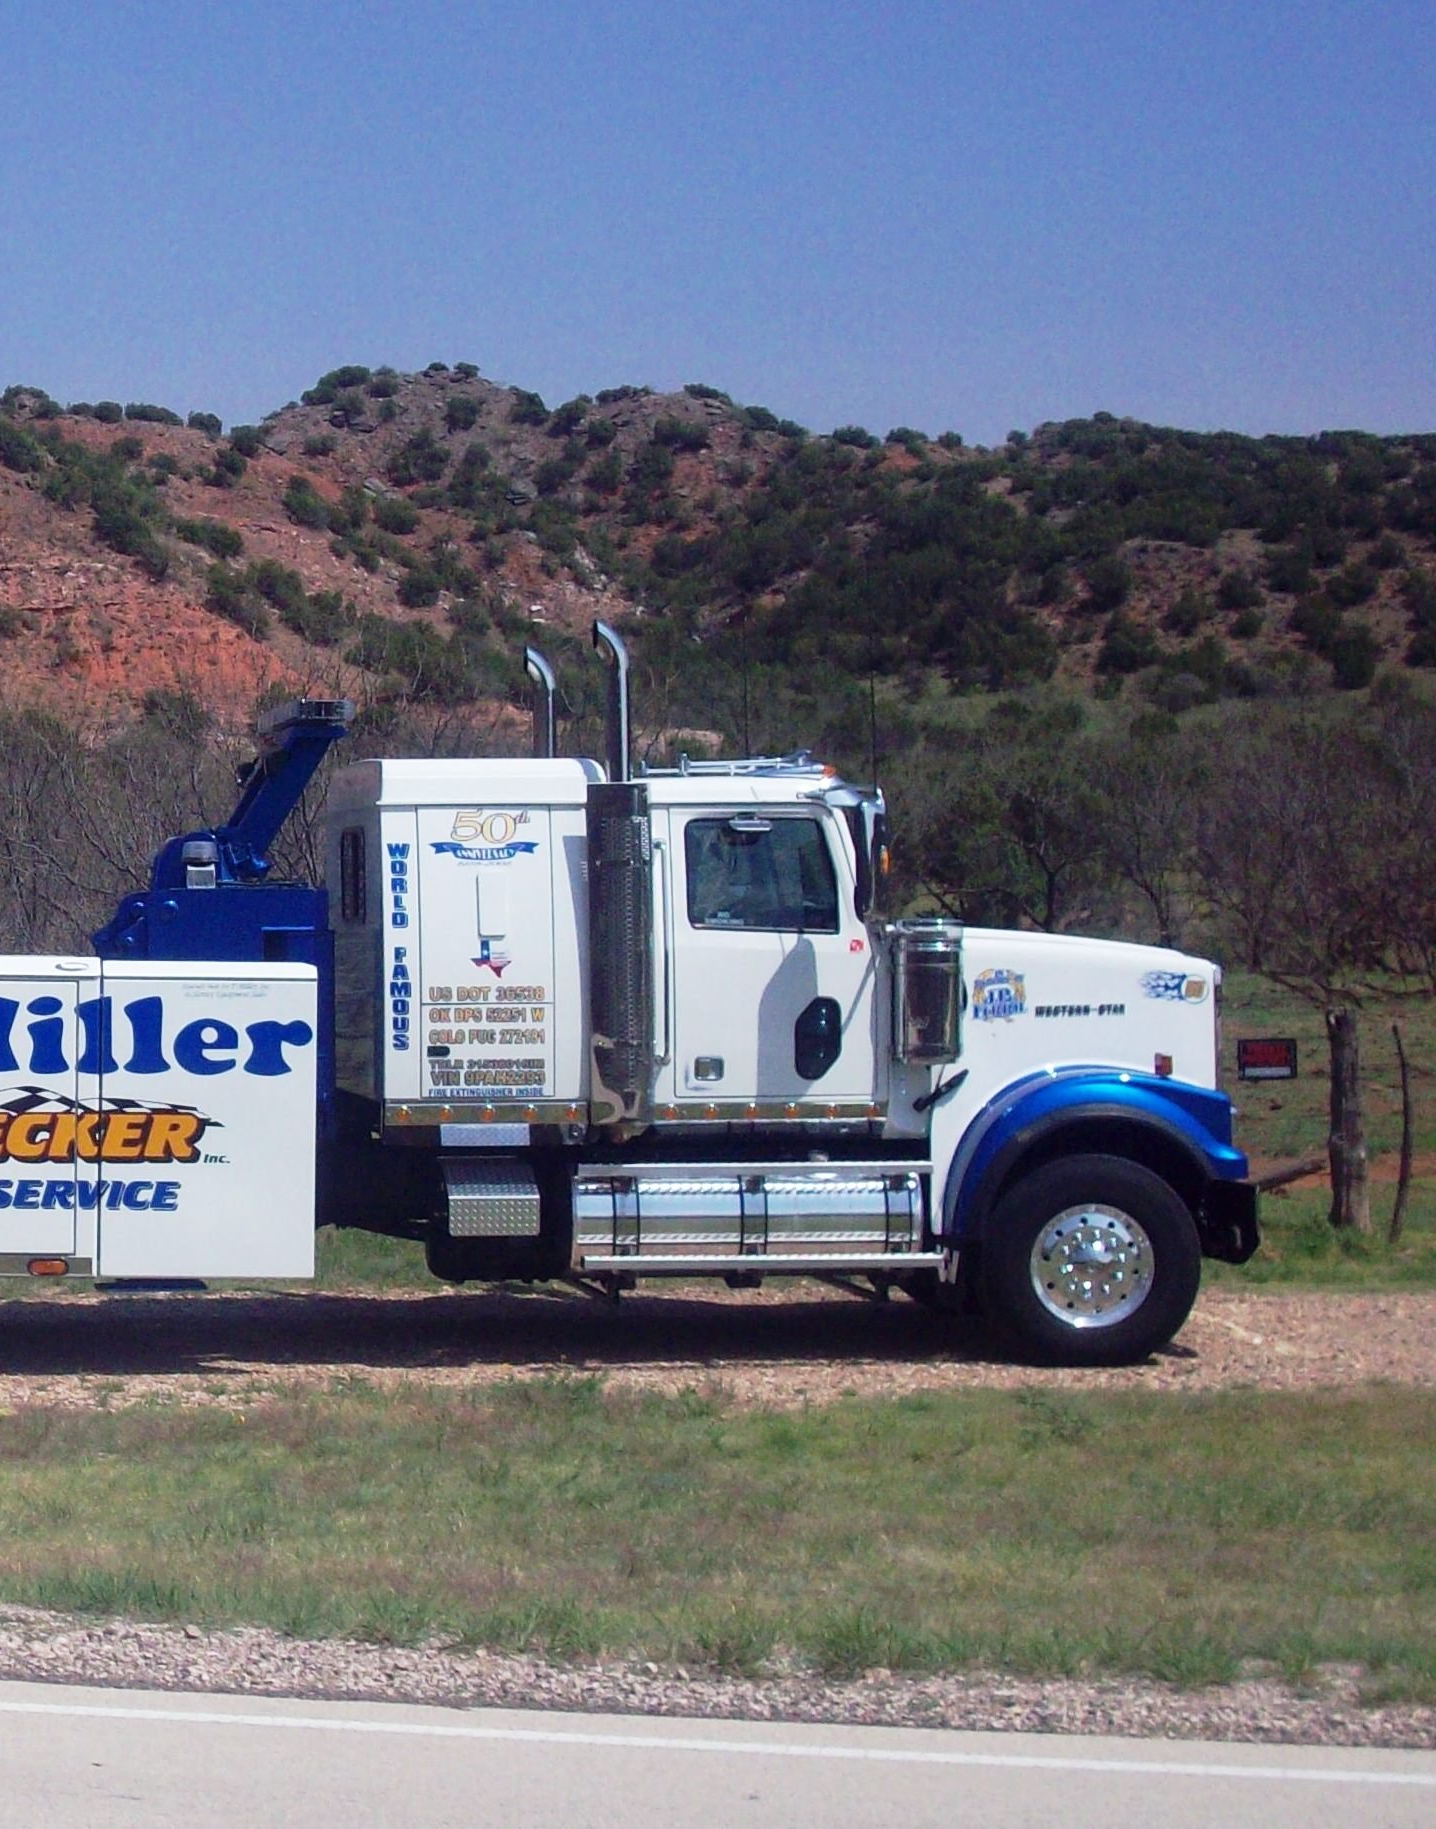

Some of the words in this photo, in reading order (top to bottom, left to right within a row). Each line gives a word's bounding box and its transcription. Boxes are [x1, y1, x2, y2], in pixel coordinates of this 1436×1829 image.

[386, 842, 411, 929] WORLD
[389, 946, 412, 1051] FAMOUS
[428, 986, 452, 1002] US
[456, 986, 491, 1002] DOT
[428, 1007, 451, 1023] OK
[530, 1007, 545, 1023] W
[429, 1087, 447, 1098] FIRE
[515, 1087, 544, 1097] INSIDE
[203, 1152, 231, 1165] Inc.
